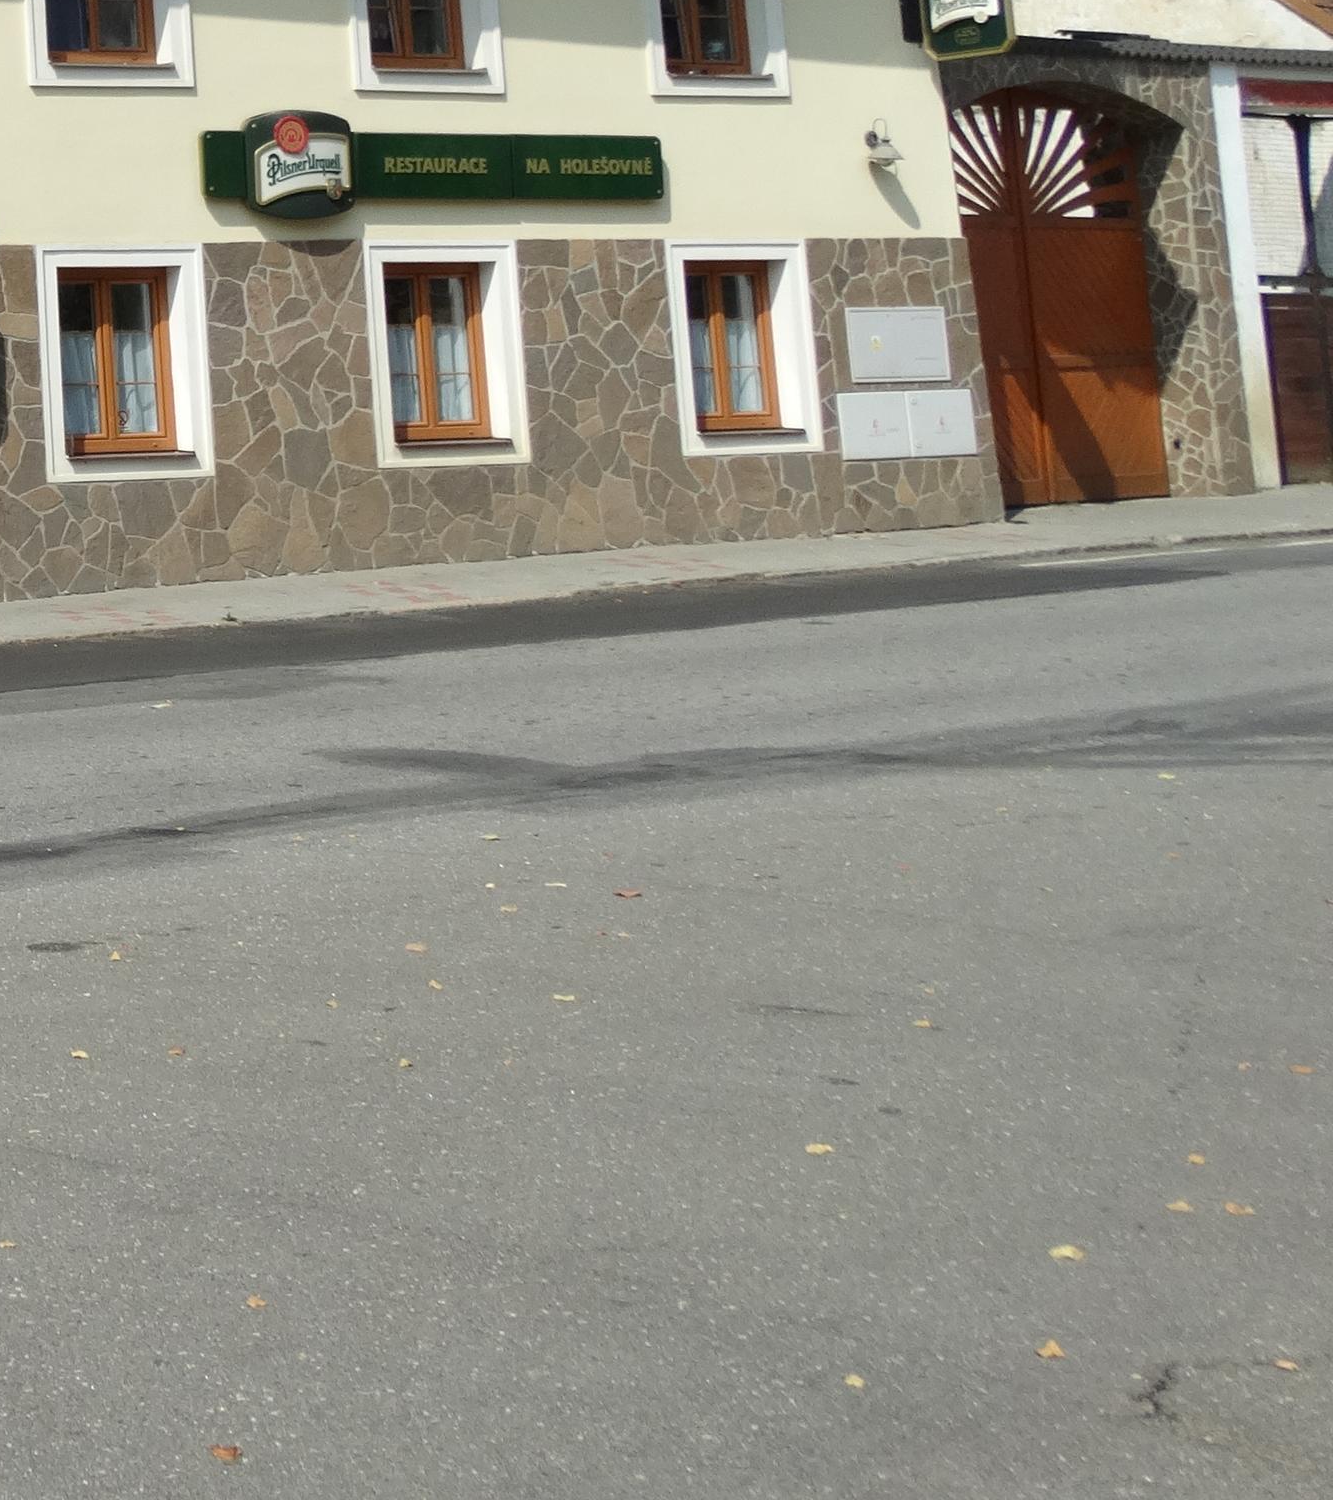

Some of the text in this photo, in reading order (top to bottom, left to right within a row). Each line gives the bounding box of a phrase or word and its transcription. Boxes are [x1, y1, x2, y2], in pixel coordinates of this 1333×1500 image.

[266, 153, 307, 187] Pilsner
[383, 156, 488, 174] RESTAURACE
[525, 157, 551, 174] NA
